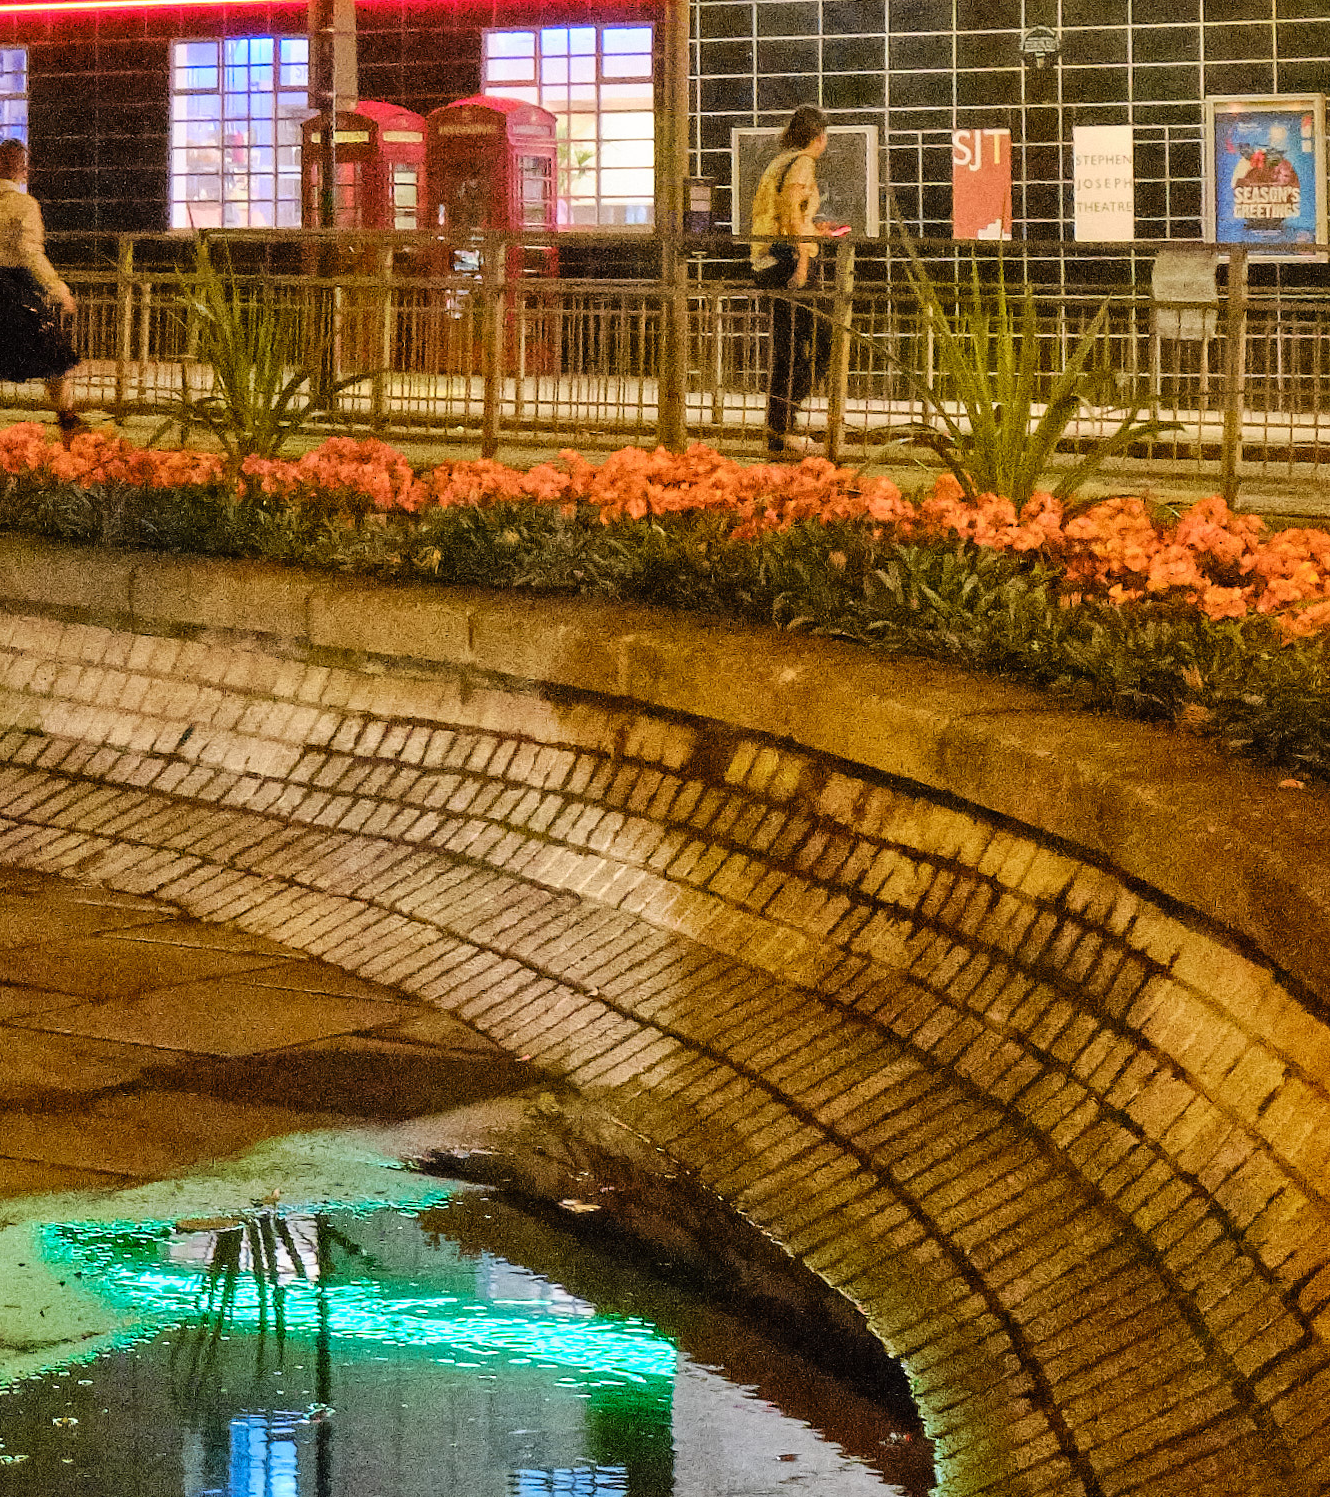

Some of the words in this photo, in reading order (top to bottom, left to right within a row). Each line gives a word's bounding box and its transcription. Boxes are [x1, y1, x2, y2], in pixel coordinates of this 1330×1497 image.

[952, 128, 1011, 172] SJT
[1076, 154, 1133, 166] STEPHEN
[1076, 177, 1133, 191] JOSEPH
[1233, 186, 1300, 203] SEASON'S
[1077, 201, 1133, 213] THEATRE
